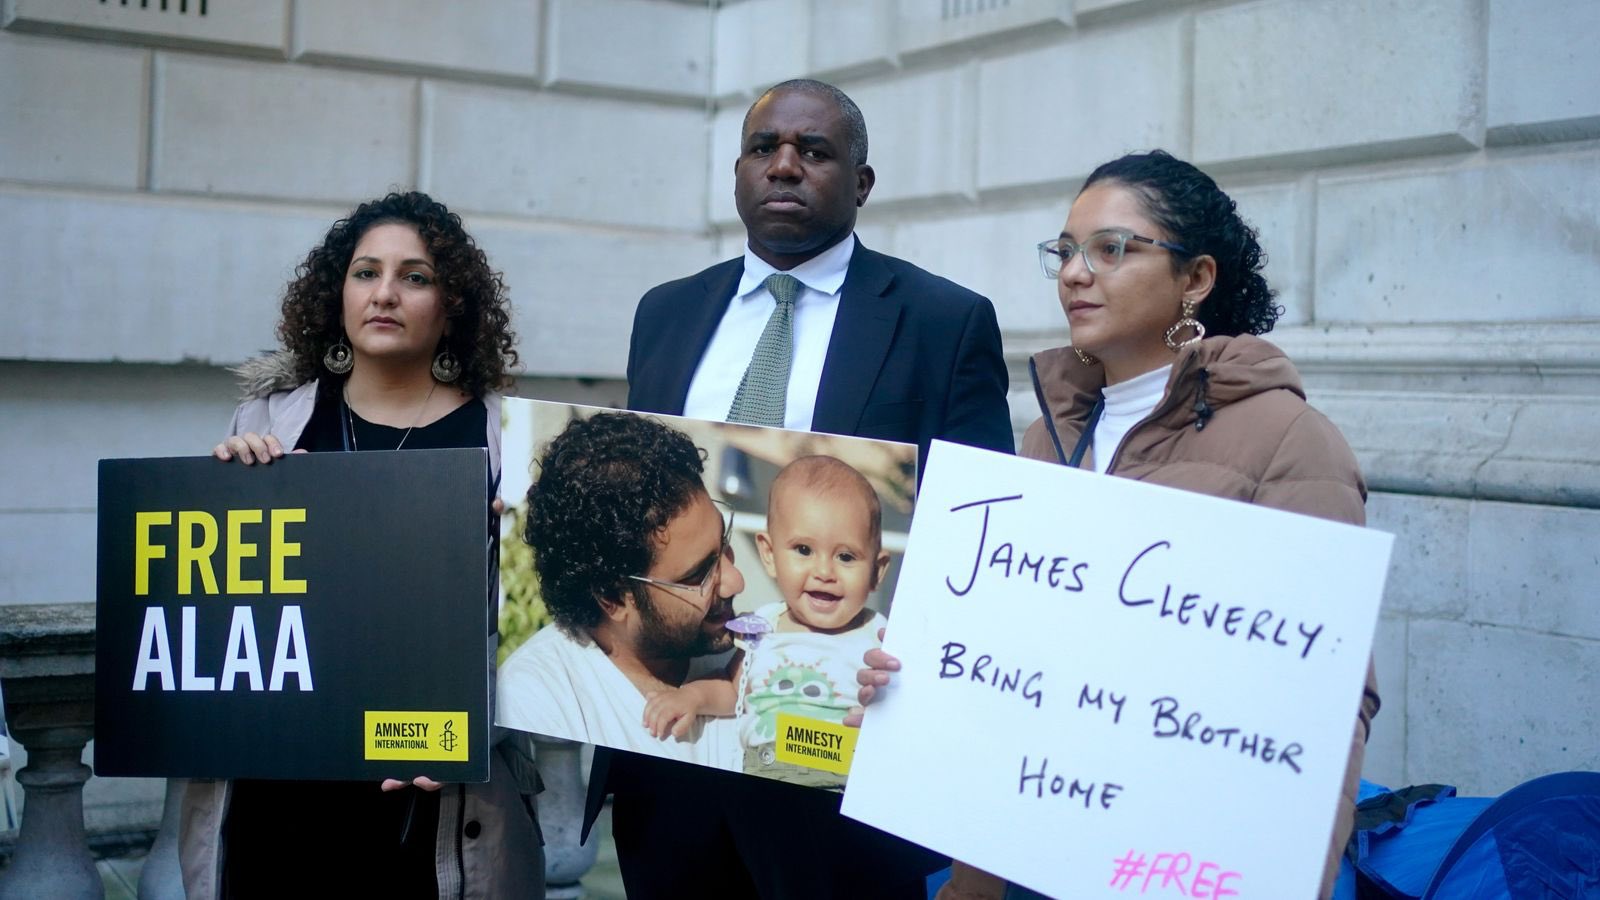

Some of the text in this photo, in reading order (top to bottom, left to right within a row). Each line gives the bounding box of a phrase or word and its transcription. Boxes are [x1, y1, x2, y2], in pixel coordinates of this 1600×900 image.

[135, 508, 308, 595] FREE
[945, 493, 1088, 597] JAMES
[132, 605, 314, 692] ALAA
[374, 722, 429, 738] AMNESTY
[938, 641, 1304, 775] BRING MY BROTHER
[374, 739, 429, 750] INTERNATIONAL
[785, 742, 843, 763] INTERNATIONAL
[786, 725, 843, 750] AMNESTY
[1018, 755, 1124, 810] HOME
